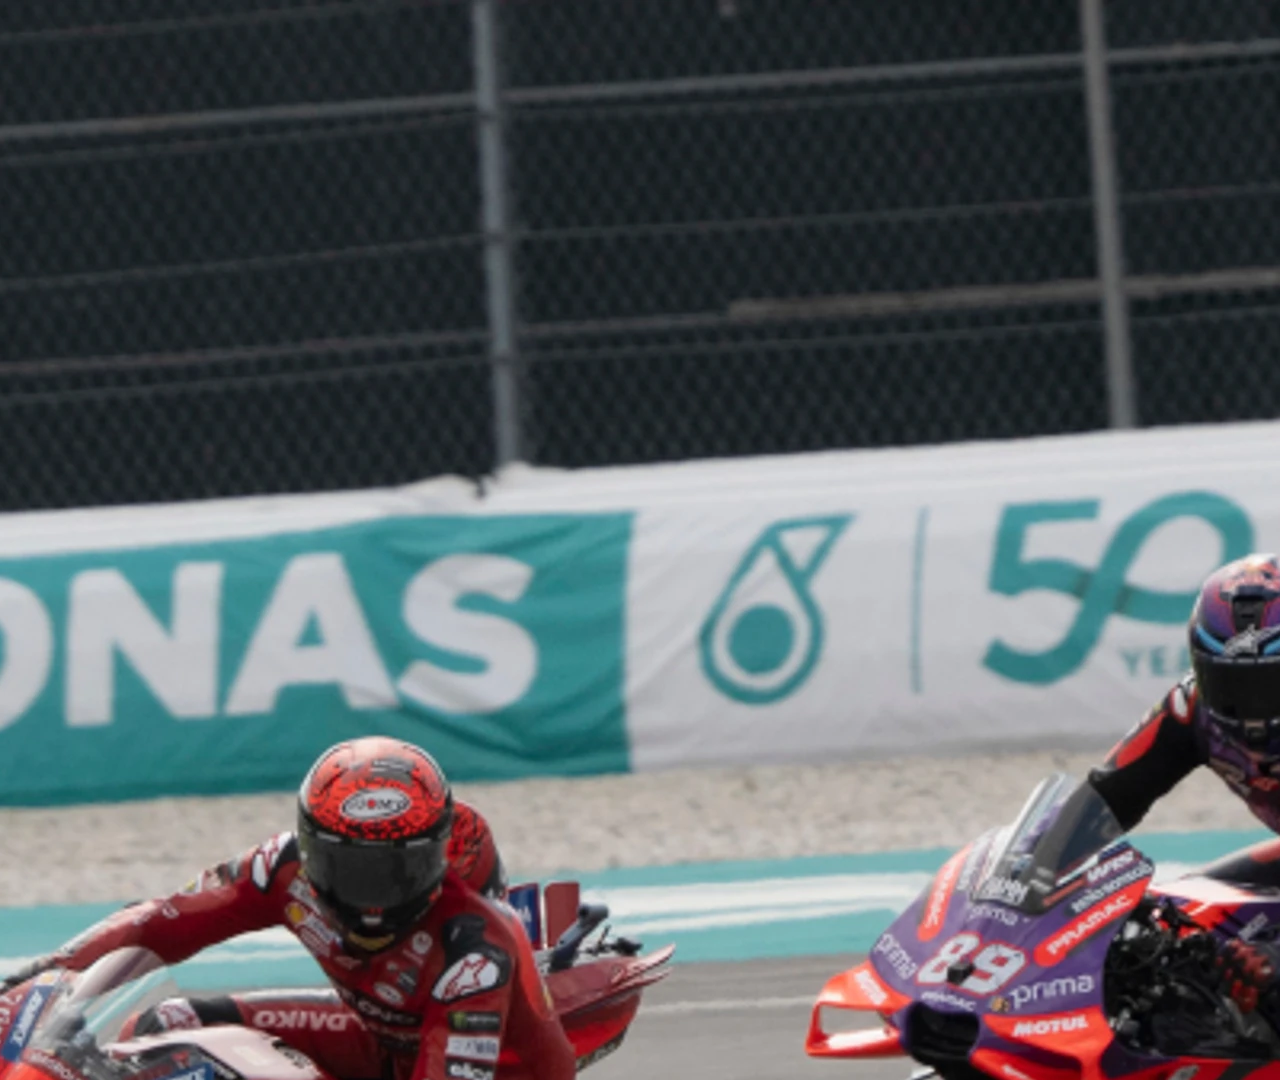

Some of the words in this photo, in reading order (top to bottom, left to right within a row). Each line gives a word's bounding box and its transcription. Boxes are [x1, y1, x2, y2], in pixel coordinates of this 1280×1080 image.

[1047, 895, 1133, 957] PRAMAC
[873, 932, 918, 980] prima
[916, 932, 1028, 995] 89
[1007, 973, 1095, 1010] prima
[1011, 1015, 1090, 1037] MOTUL
